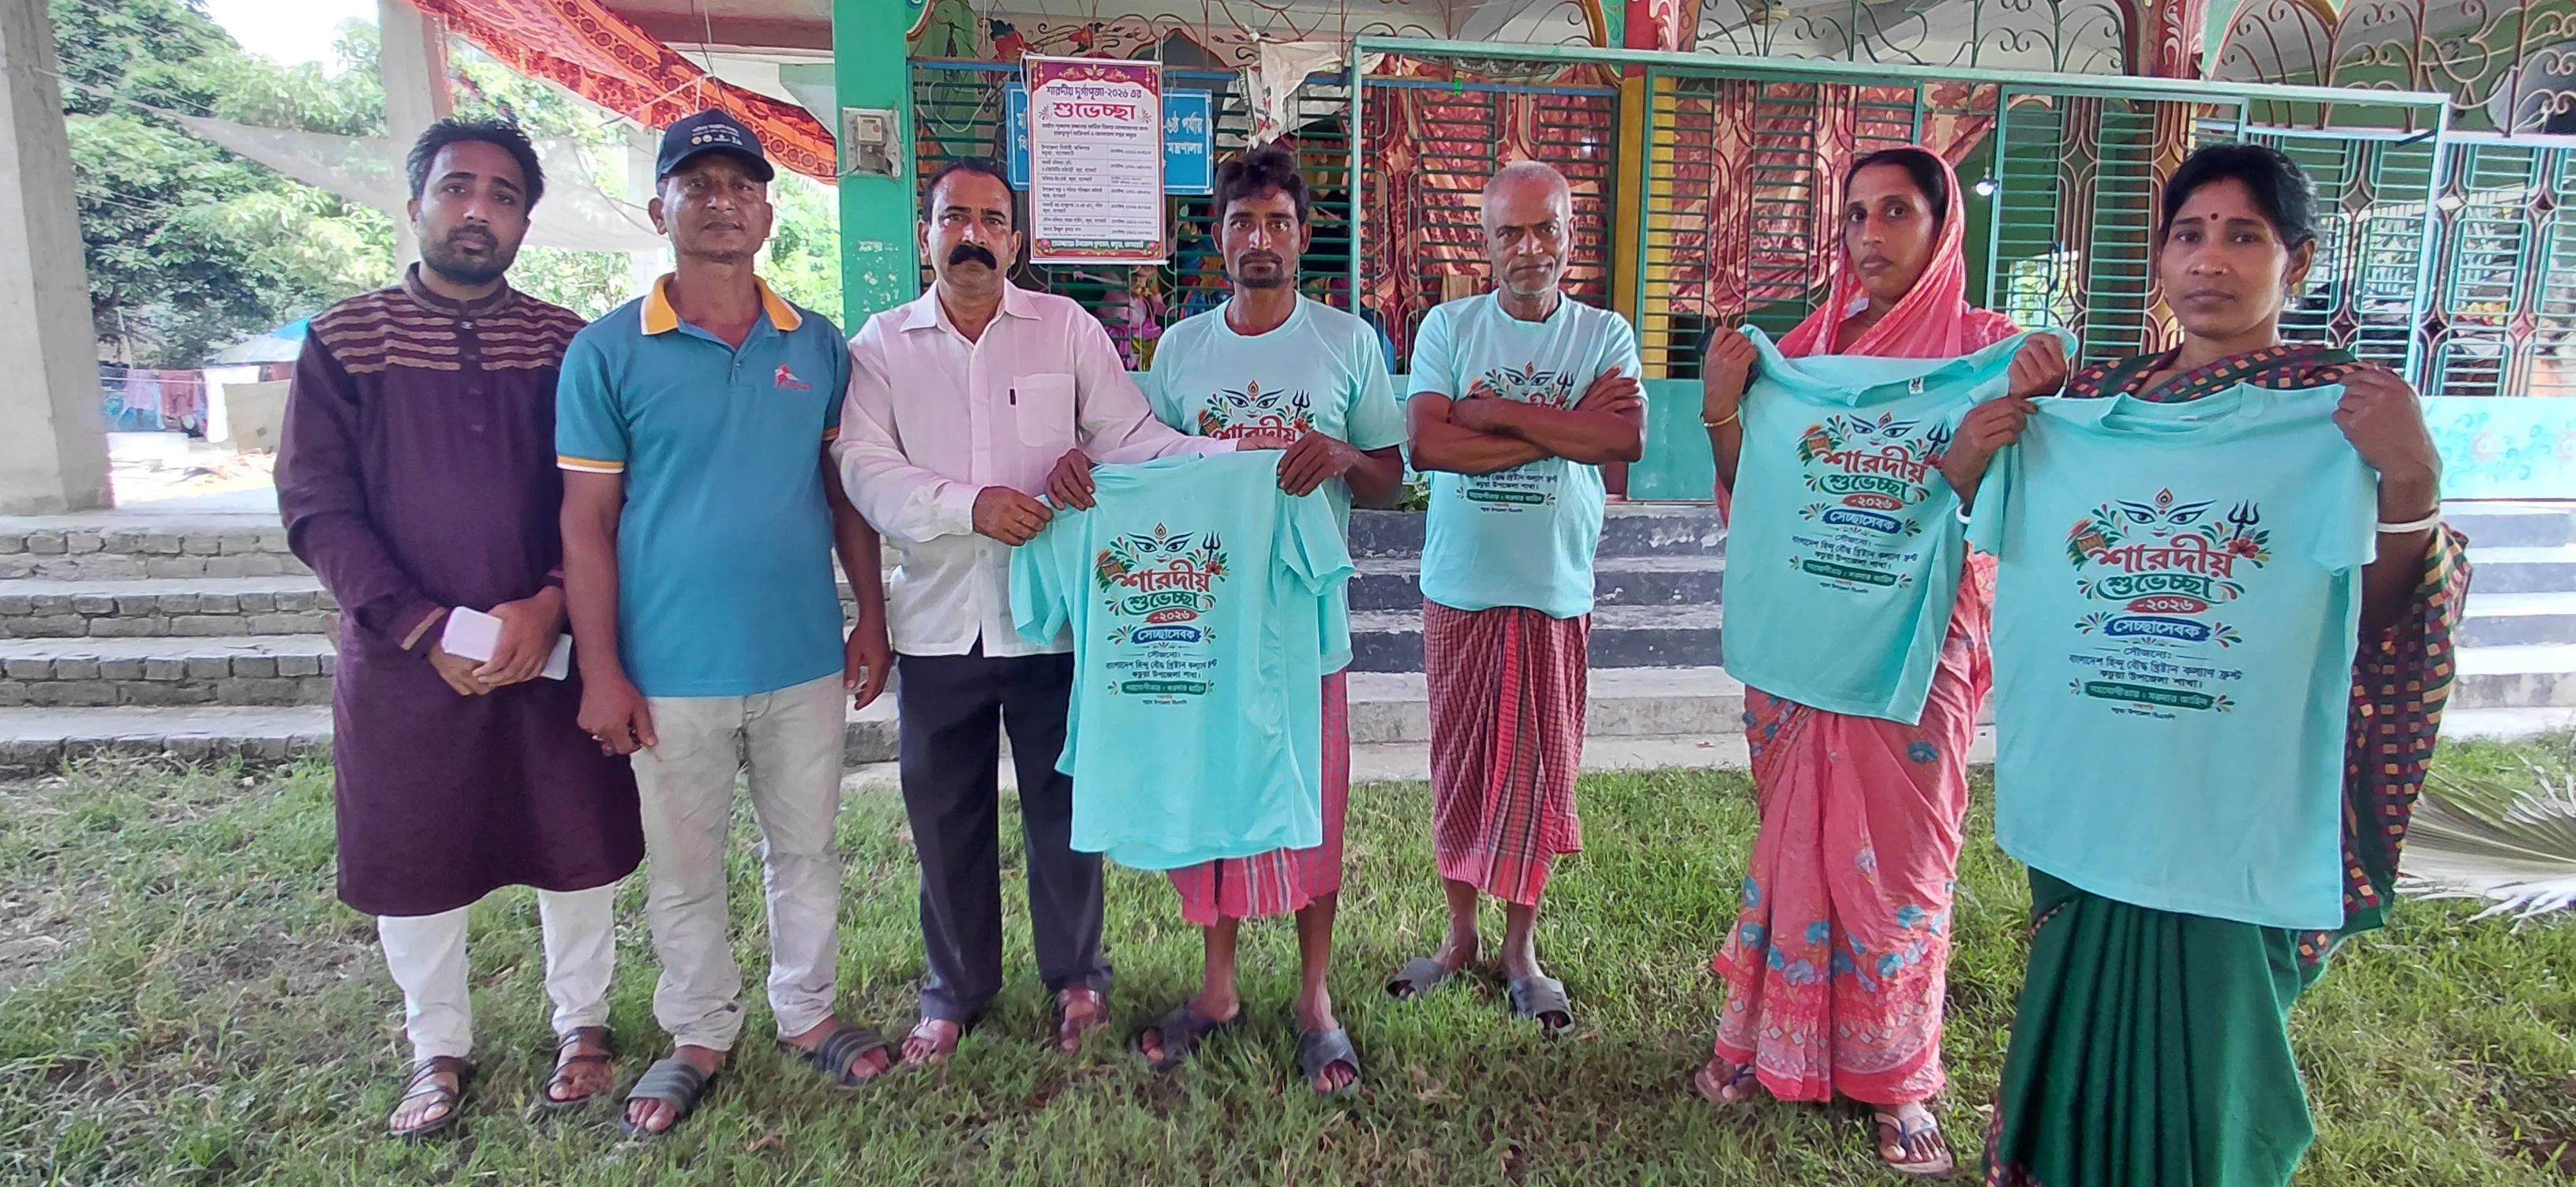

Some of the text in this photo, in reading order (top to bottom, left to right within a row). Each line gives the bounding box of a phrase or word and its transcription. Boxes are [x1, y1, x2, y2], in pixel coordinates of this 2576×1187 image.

[1046, 83, 1073, 97] শারদীয়
[1130, 89, 1142, 99] এর
[1052, 102, 1136, 122] শুভেচ্ছা
[1814, 445, 1928, 485] শারদীয়
[1828, 474, 1910, 500] শুভেচ্ছা
[2087, 534, 2237, 578] শারদীয়
[1111, 559, 1211, 593] শারদীয়
[2106, 573, 2215, 598] শুভেচ্ছা
[1128, 591, 1200, 610] শুভেচ্ছা
[2106, 656, 2125, 671] হিন্দু
[2127, 658, 2148, 671] বৌদ্ধ
[2128, 672, 2170, 685] উপজেলা
